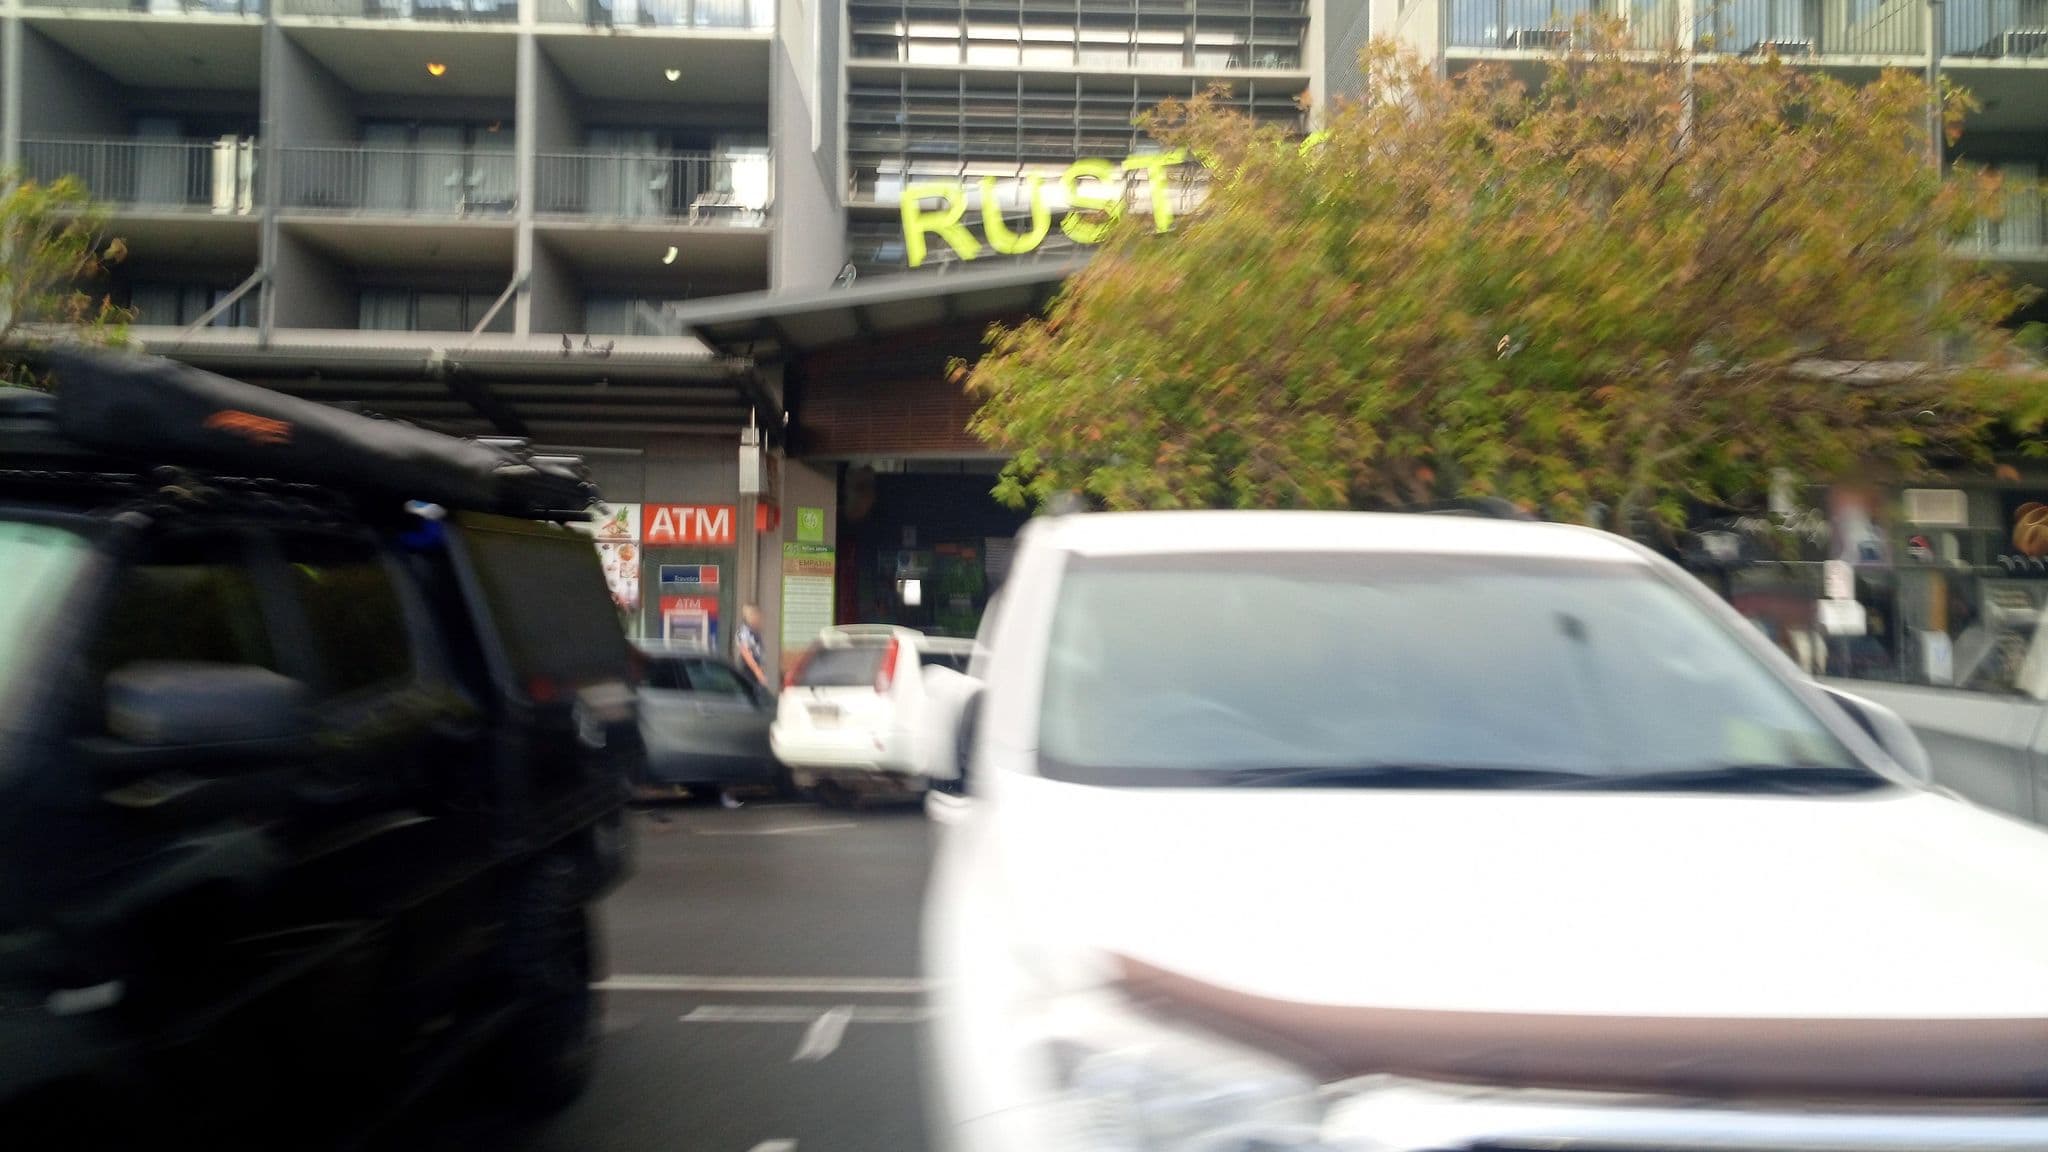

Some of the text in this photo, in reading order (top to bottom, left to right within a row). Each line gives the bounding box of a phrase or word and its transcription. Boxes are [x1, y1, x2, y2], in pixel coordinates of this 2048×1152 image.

[901, 131, 1340, 268] RUST
[648, 507, 730, 537] ATM
[674, 598, 701, 609] ATM
